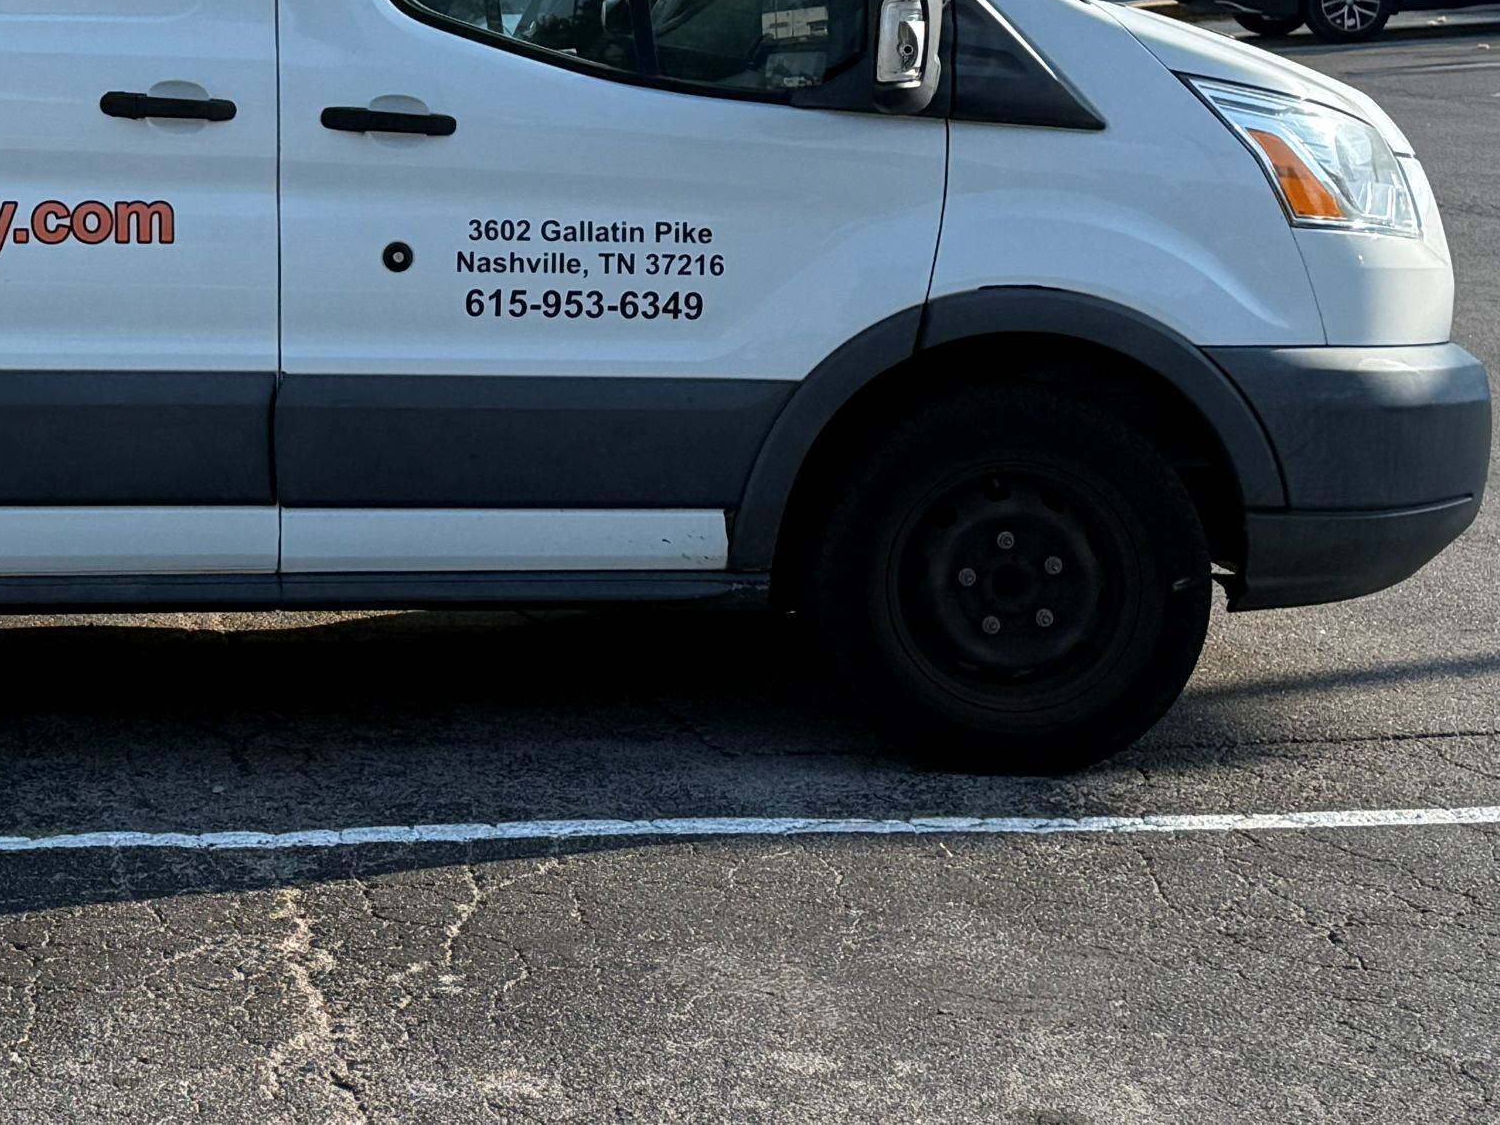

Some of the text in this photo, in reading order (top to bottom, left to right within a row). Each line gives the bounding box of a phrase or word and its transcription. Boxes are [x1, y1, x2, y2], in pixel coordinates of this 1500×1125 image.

[468, 218, 713, 245] 3602 Gallatin Pike
[456, 250, 726, 279] Nashville, TN 37216
[464, 288, 704, 321] 615-953-6349
